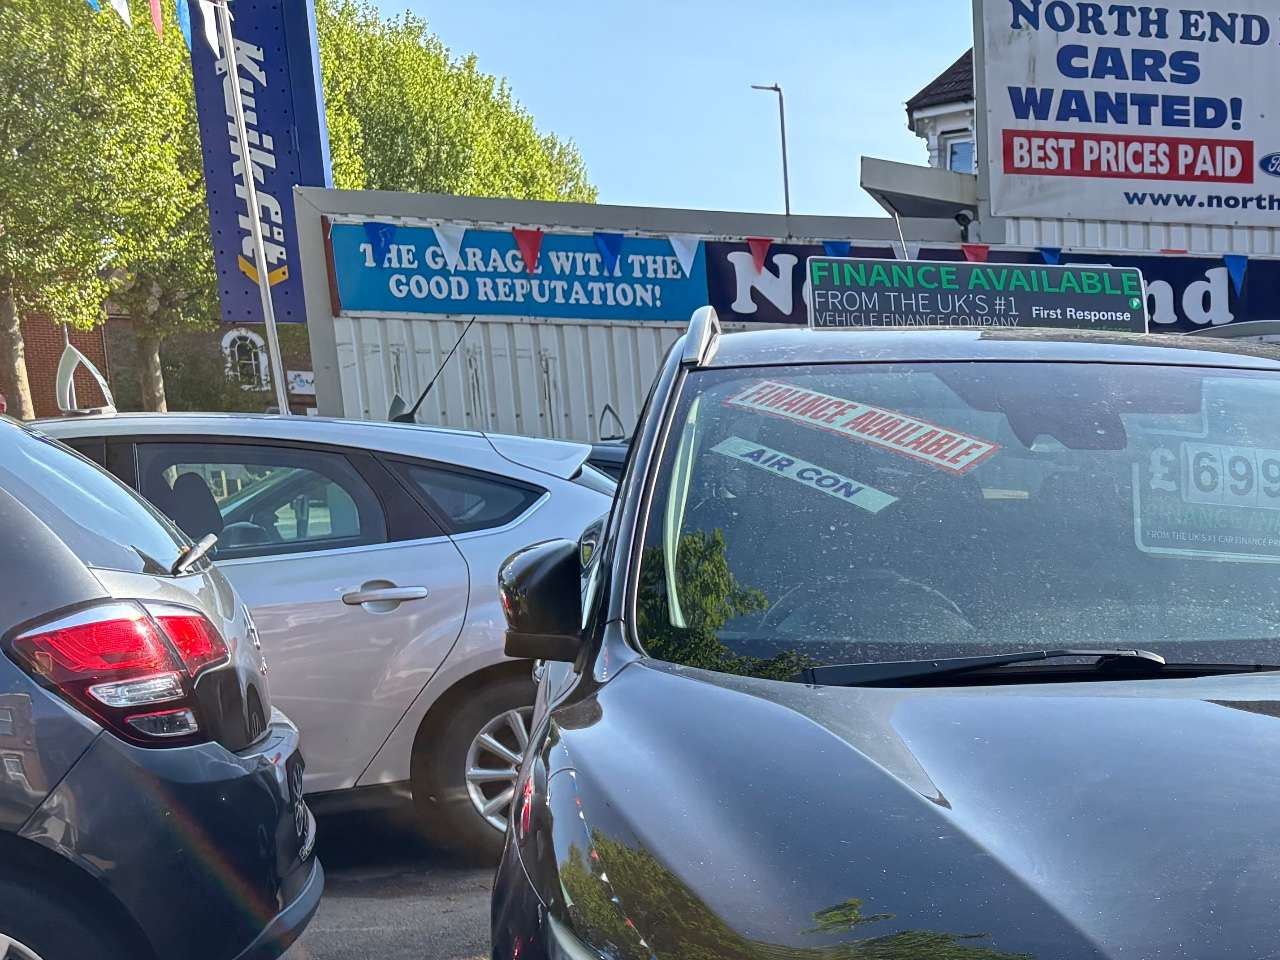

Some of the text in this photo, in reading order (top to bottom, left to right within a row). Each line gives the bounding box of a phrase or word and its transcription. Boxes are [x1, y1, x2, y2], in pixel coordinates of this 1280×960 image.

[1010, 0, 1169, 39] NORTH
[1180, 10, 1270, 46] END
[1056, 44, 1201, 85] CARS
[1007, 86, 1243, 131] WANTED!
[1012, 136, 1243, 178] BEST PRICES PAID
[628, 254, 683, 279] THE
[811, 261, 960, 290] FINANCE
[968, 267, 1142, 296] AVAILABLE
[389, 274, 662, 308] GOOD REPUTATION!
[814, 290, 1020, 315] FROM THE UK'S #1
[816, 312, 1019, 328] VEHICLE FINANCE COMPANY
[1032, 306, 1131, 323] First Response
[742, 382, 983, 466] FINANCE AVAILABLE
[739, 448, 862, 499] AIR CON
